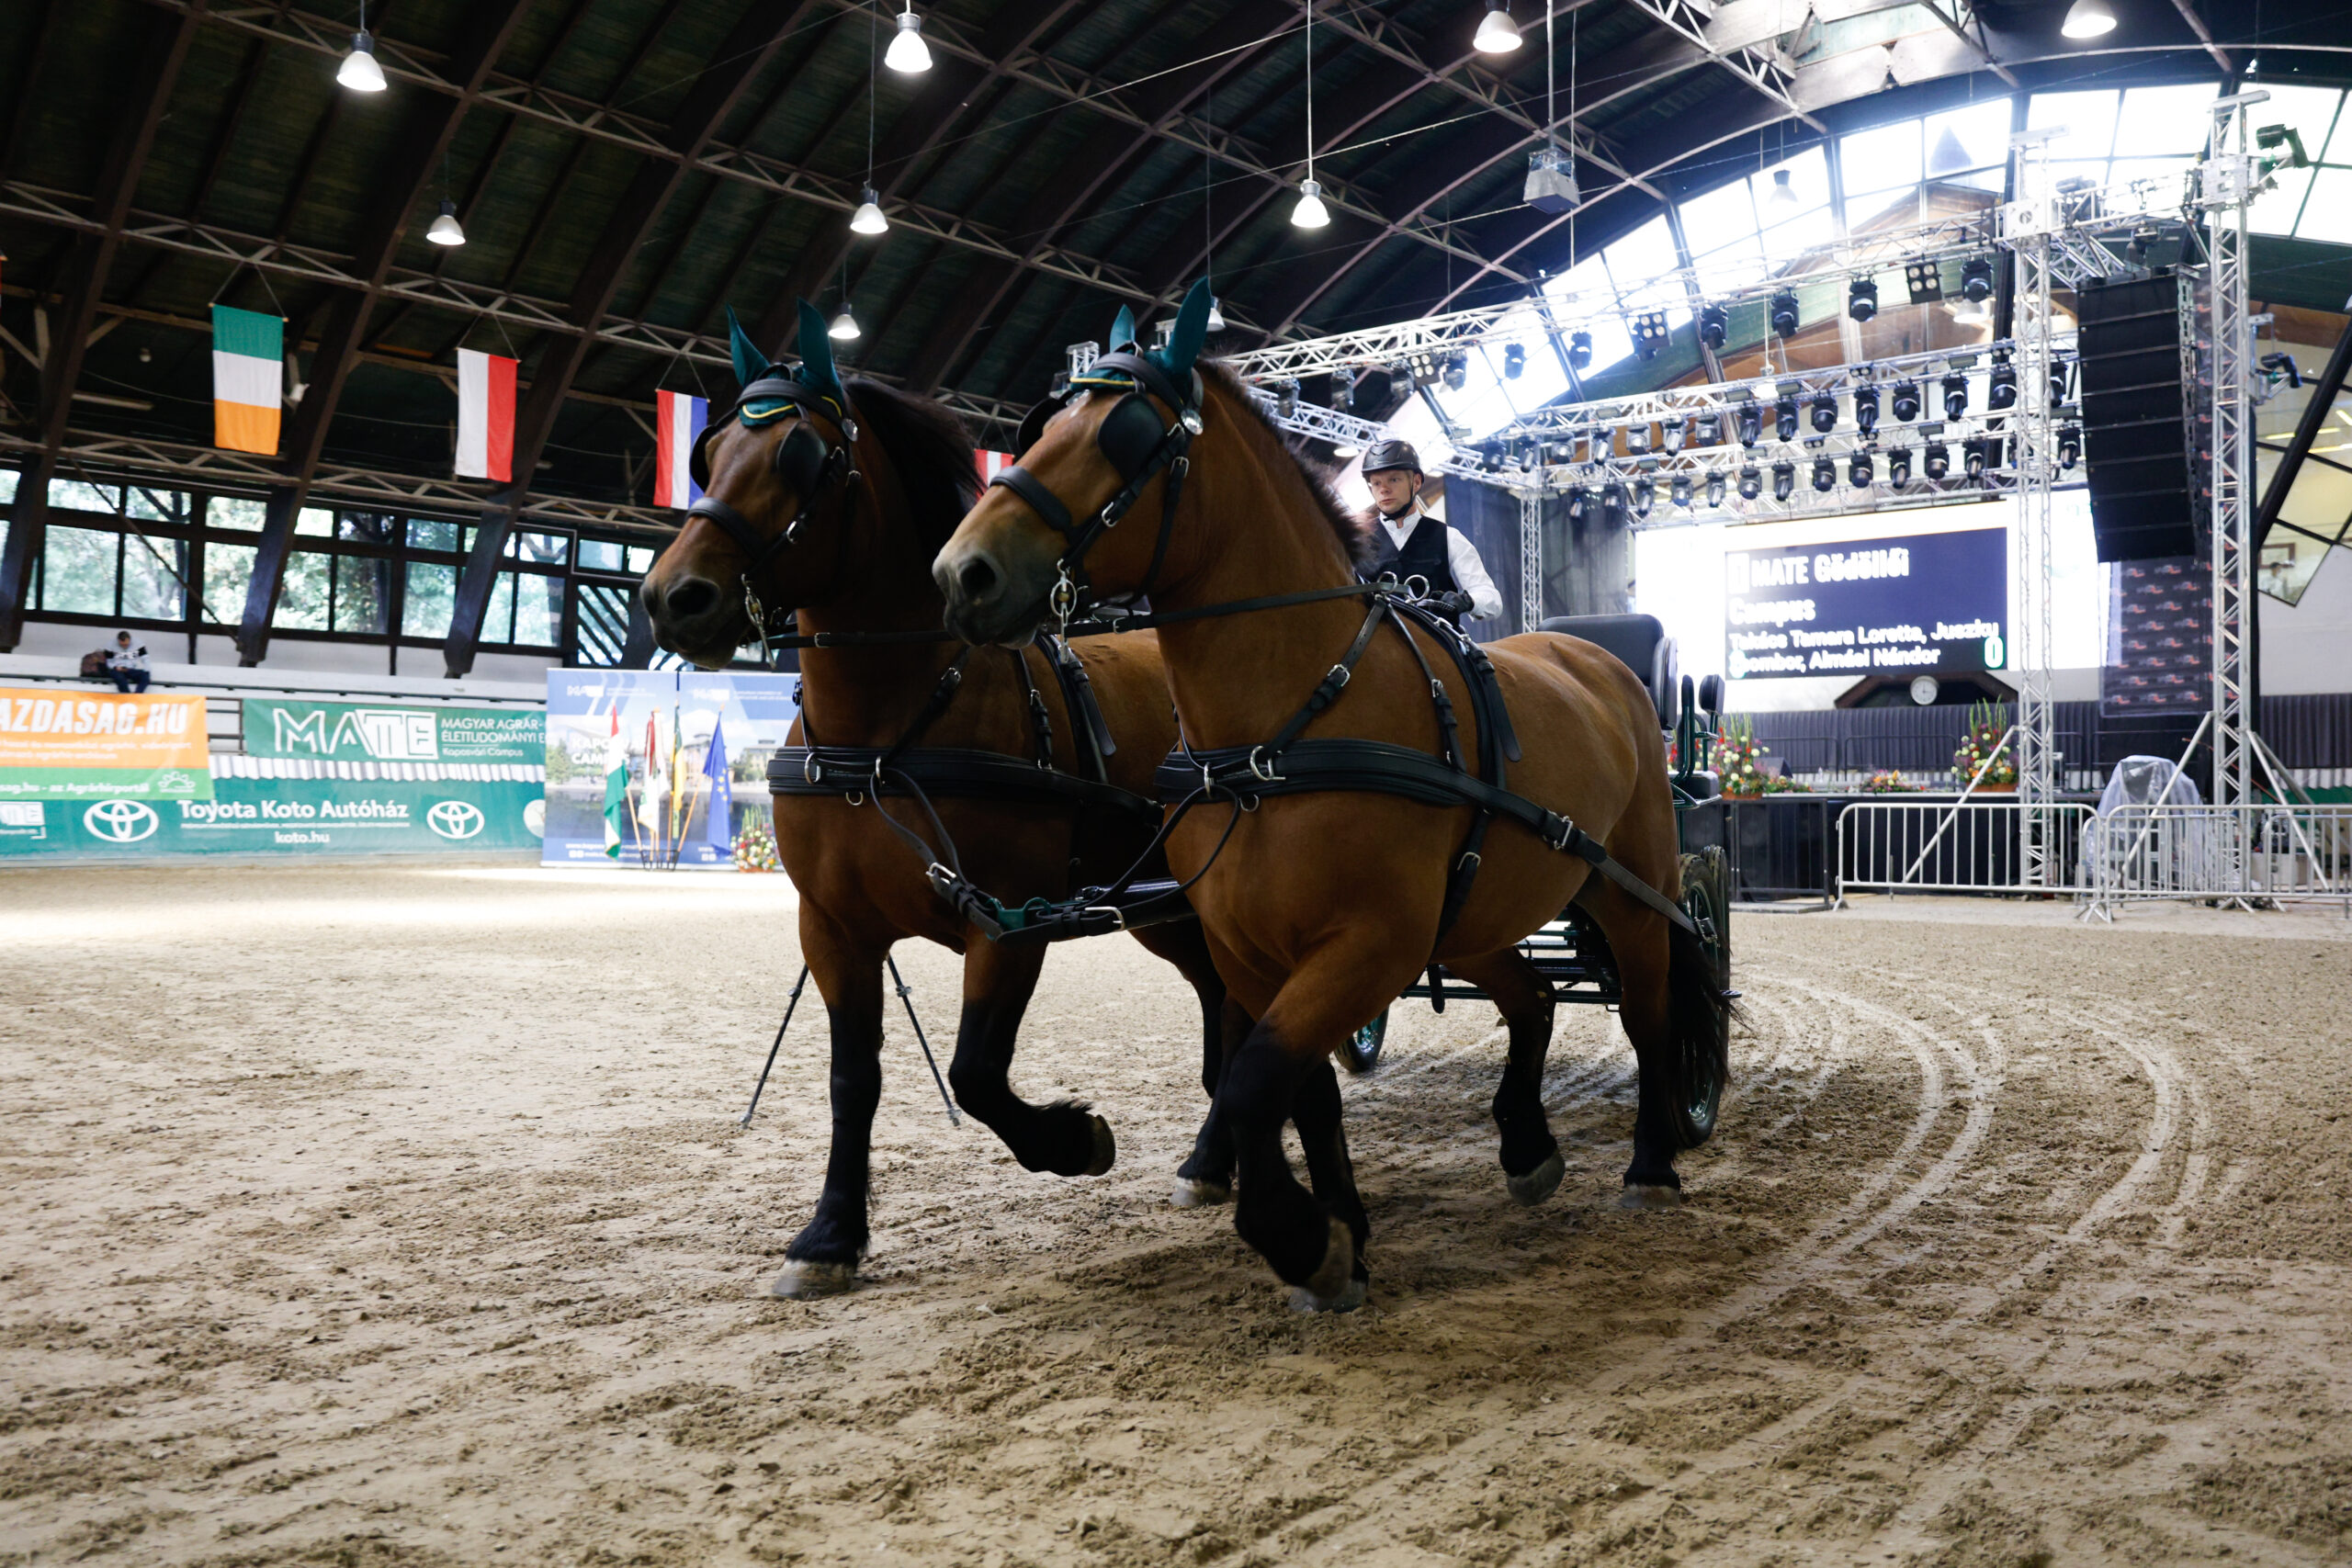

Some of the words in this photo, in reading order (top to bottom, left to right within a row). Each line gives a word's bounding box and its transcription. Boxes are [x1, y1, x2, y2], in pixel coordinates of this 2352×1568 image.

[1750, 556, 1809, 588] MATE
[1728, 597, 1815, 627] Campus
[1790, 629, 1855, 648] Tamara
[1858, 626, 1928, 644] Loretta,
[1873, 647, 1941, 666] Nándor
[441, 717, 495, 729] MAGYAR
[273, 708, 439, 760] MATE
[441, 729, 537, 743] ÉLETTUDOMÁNYI
[487, 748, 524, 758] Campus
[177, 799, 257, 823] Toyota
[260, 800, 316, 818] Koto
[319, 799, 410, 818] Autóház
[274, 830, 331, 844] koto.hu
